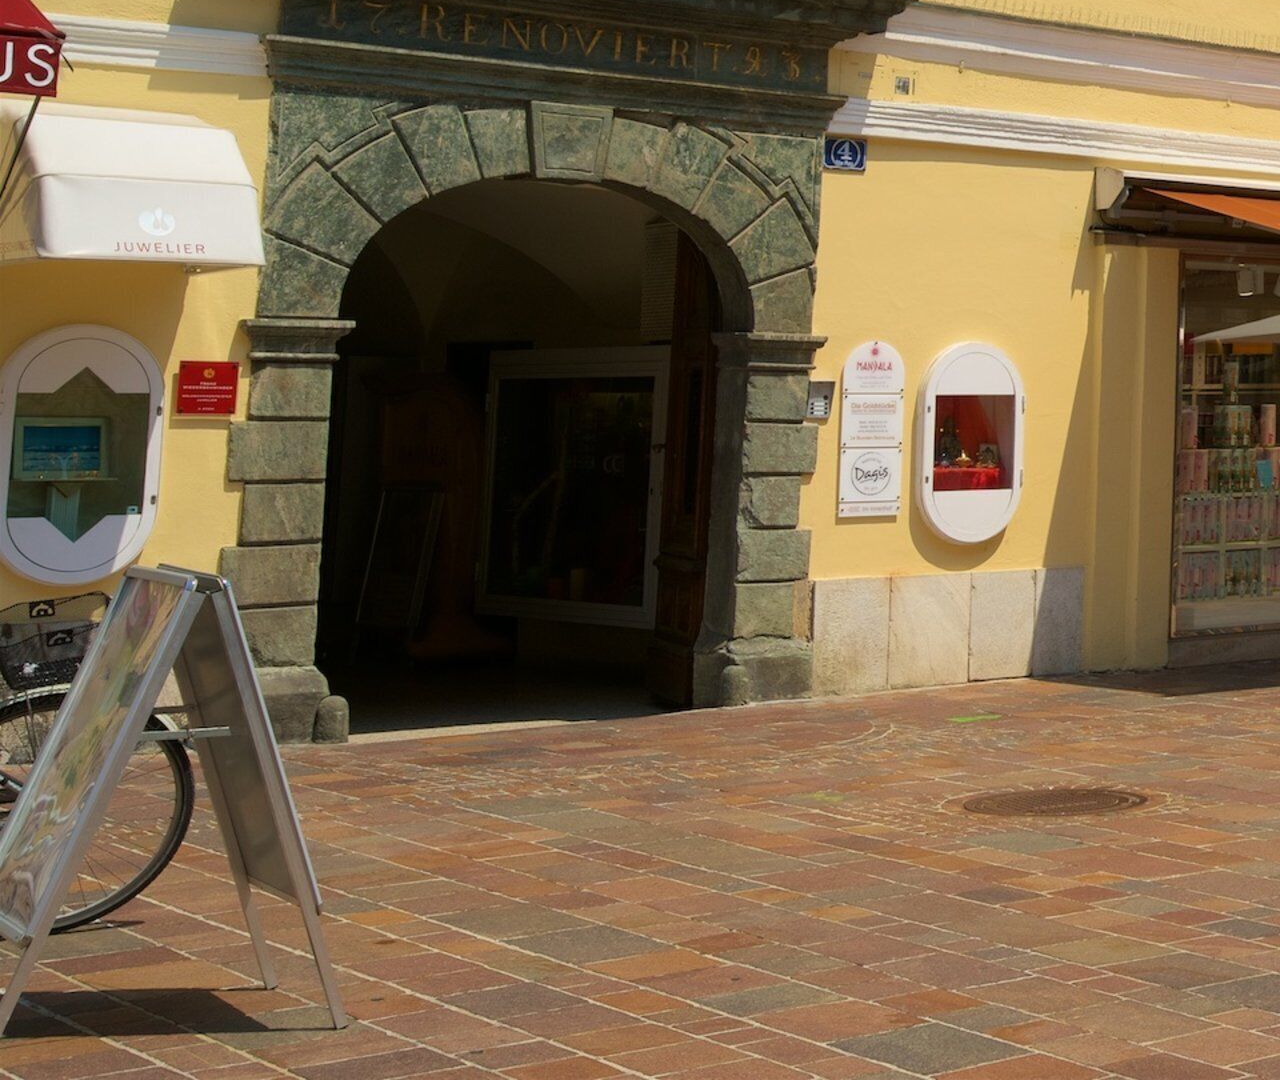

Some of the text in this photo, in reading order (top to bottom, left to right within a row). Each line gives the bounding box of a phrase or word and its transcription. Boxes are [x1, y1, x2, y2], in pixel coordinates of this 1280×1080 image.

[836, 140, 853, 161] 4
[114, 241, 206, 255] JUWELIER
[855, 466, 888, 482] Dagis
